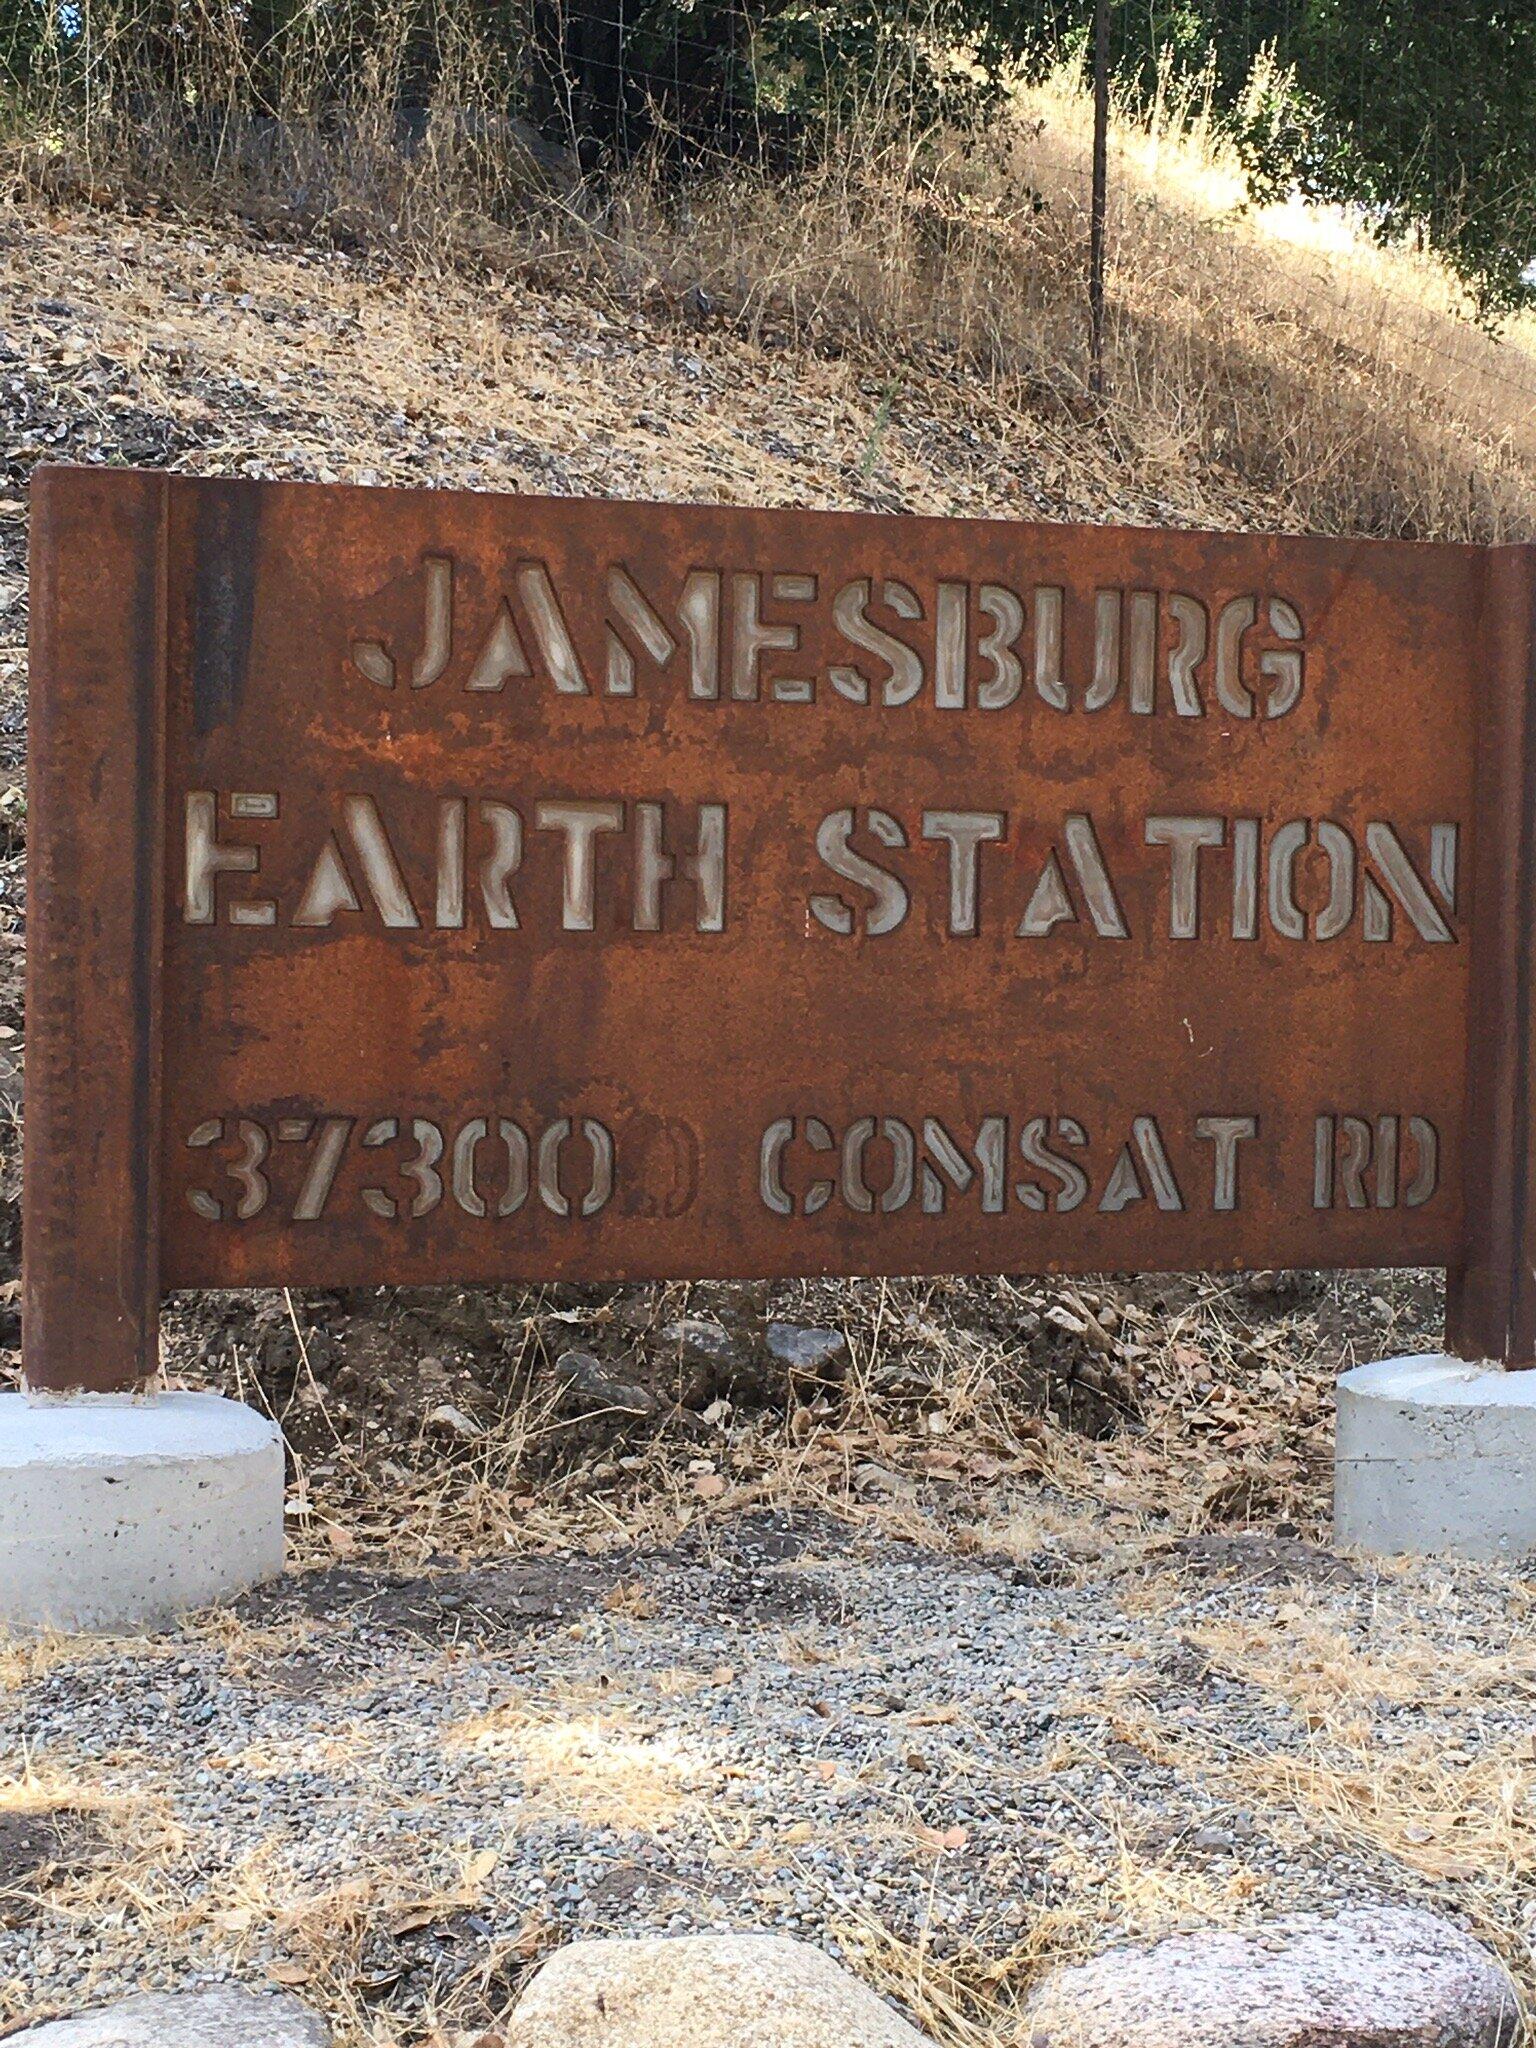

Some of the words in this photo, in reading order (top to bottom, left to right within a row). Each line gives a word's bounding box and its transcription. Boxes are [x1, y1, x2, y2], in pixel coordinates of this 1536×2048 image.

[350, 554, 1305, 718] JAMESBURG
[183, 791, 728, 932] EARTH
[808, 807, 1458, 943] STATION
[759, 1115, 1258, 1215] COMSAT
[1313, 1115, 1439, 1211] RD
